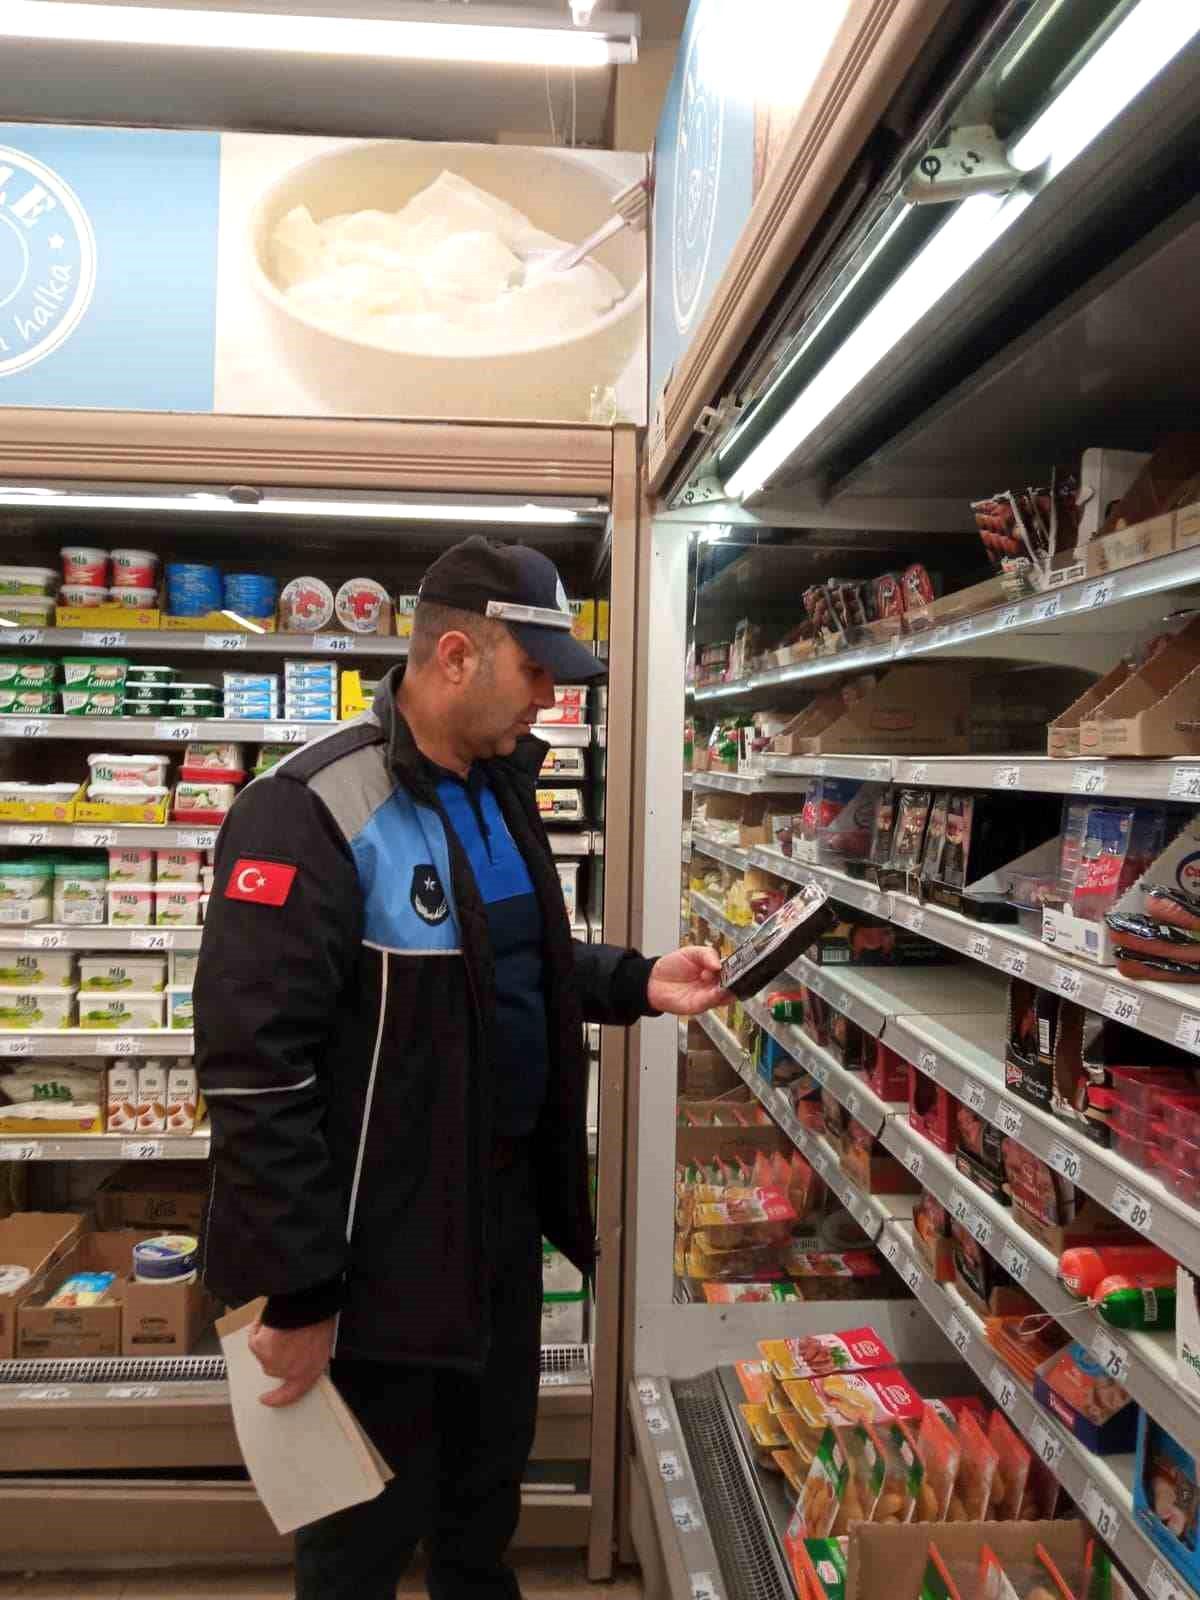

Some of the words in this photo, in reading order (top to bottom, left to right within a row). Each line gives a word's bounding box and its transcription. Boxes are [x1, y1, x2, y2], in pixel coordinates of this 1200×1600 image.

[14, 262, 72, 341] halka
[100, 636, 117, 647] 42
[222, 639, 238, 649] 29
[330, 640, 346, 649] 48
[172, 728, 189, 739] 49
[1115, 1000, 1133, 1018] 269
[1003, 1116, 1016, 1132] 109
[1064, 1157, 1077, 1177] 90
[1130, 1204, 1147, 1227] 89
[1106, 1349, 1122, 1376] 75
[1042, 1440, 1054, 1460] 19
[1097, 1509, 1110, 1535] 13
